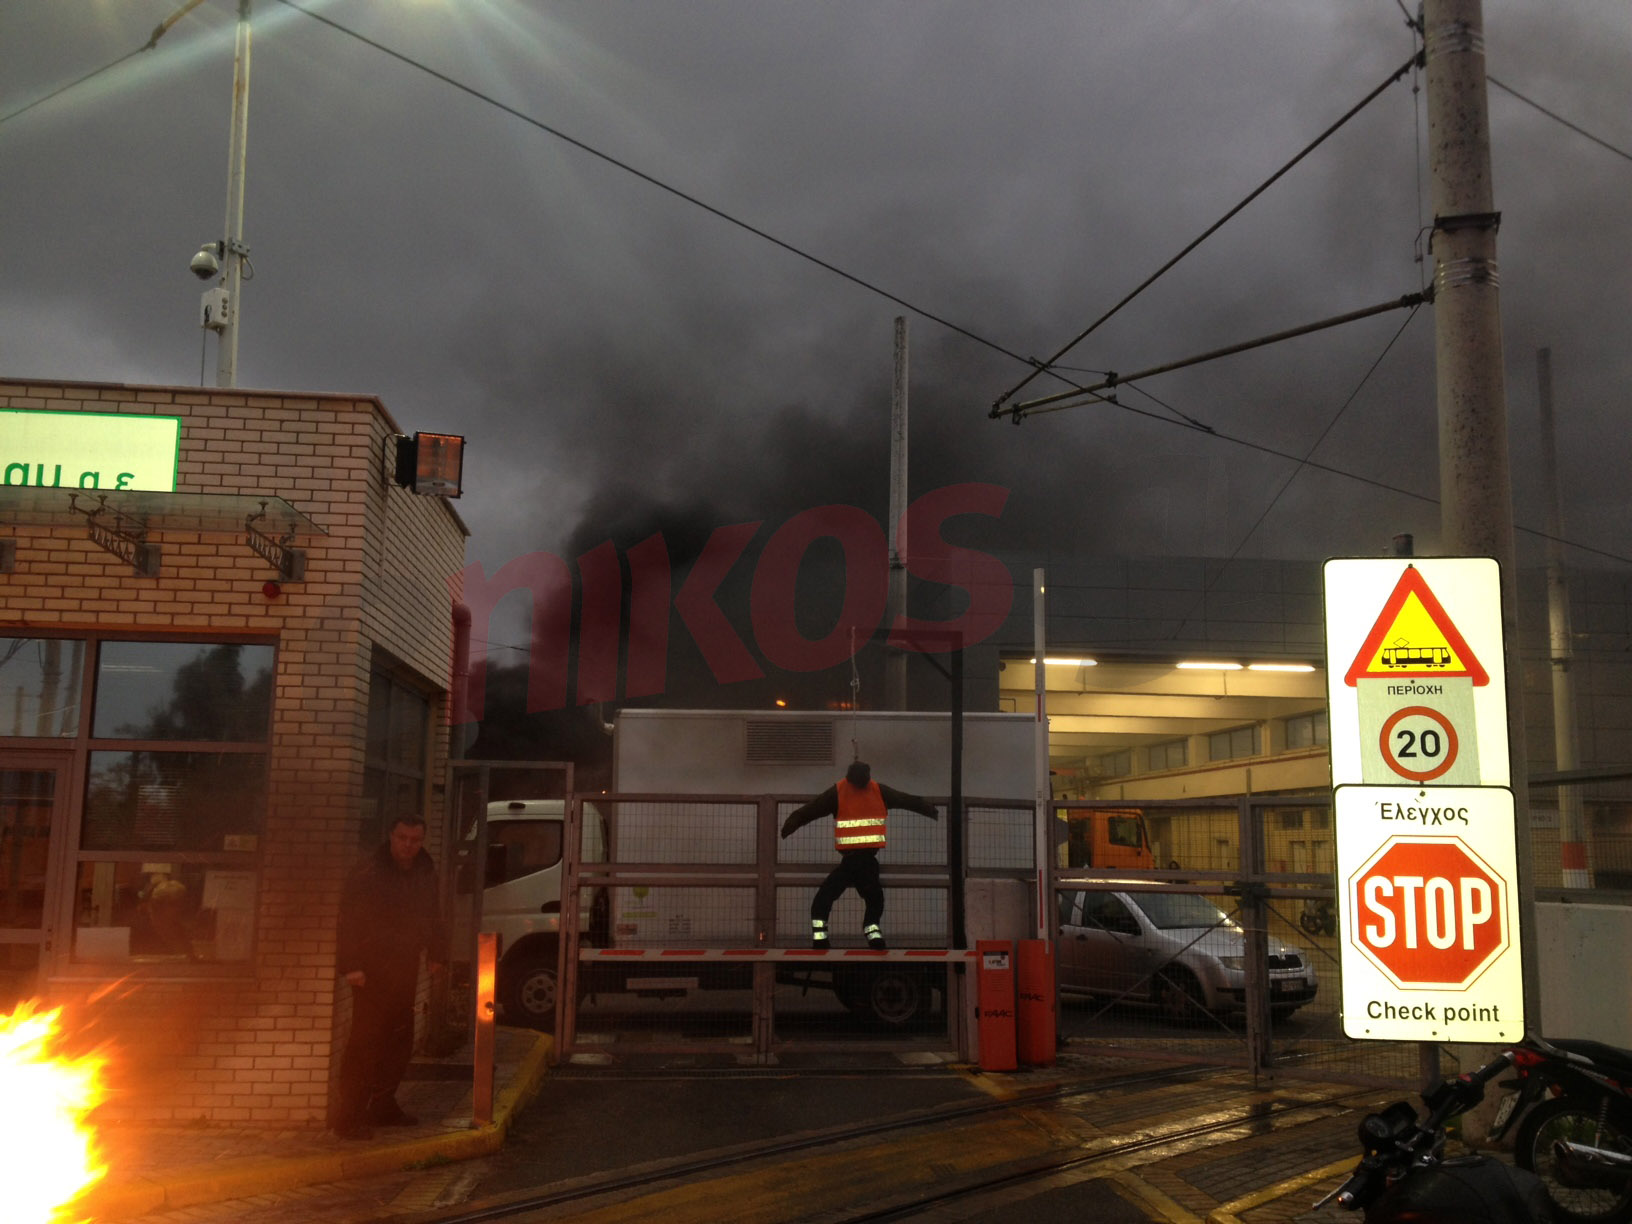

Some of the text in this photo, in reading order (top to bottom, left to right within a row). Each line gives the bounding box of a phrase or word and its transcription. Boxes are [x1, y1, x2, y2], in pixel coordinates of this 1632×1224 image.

[1387, 685, 1443, 696] ΠΕΡΙΟΧΗ
[1397, 729, 1441, 758] 20
[1364, 875, 1493, 951] STOP
[1367, 1000, 1500, 1026] Check point
